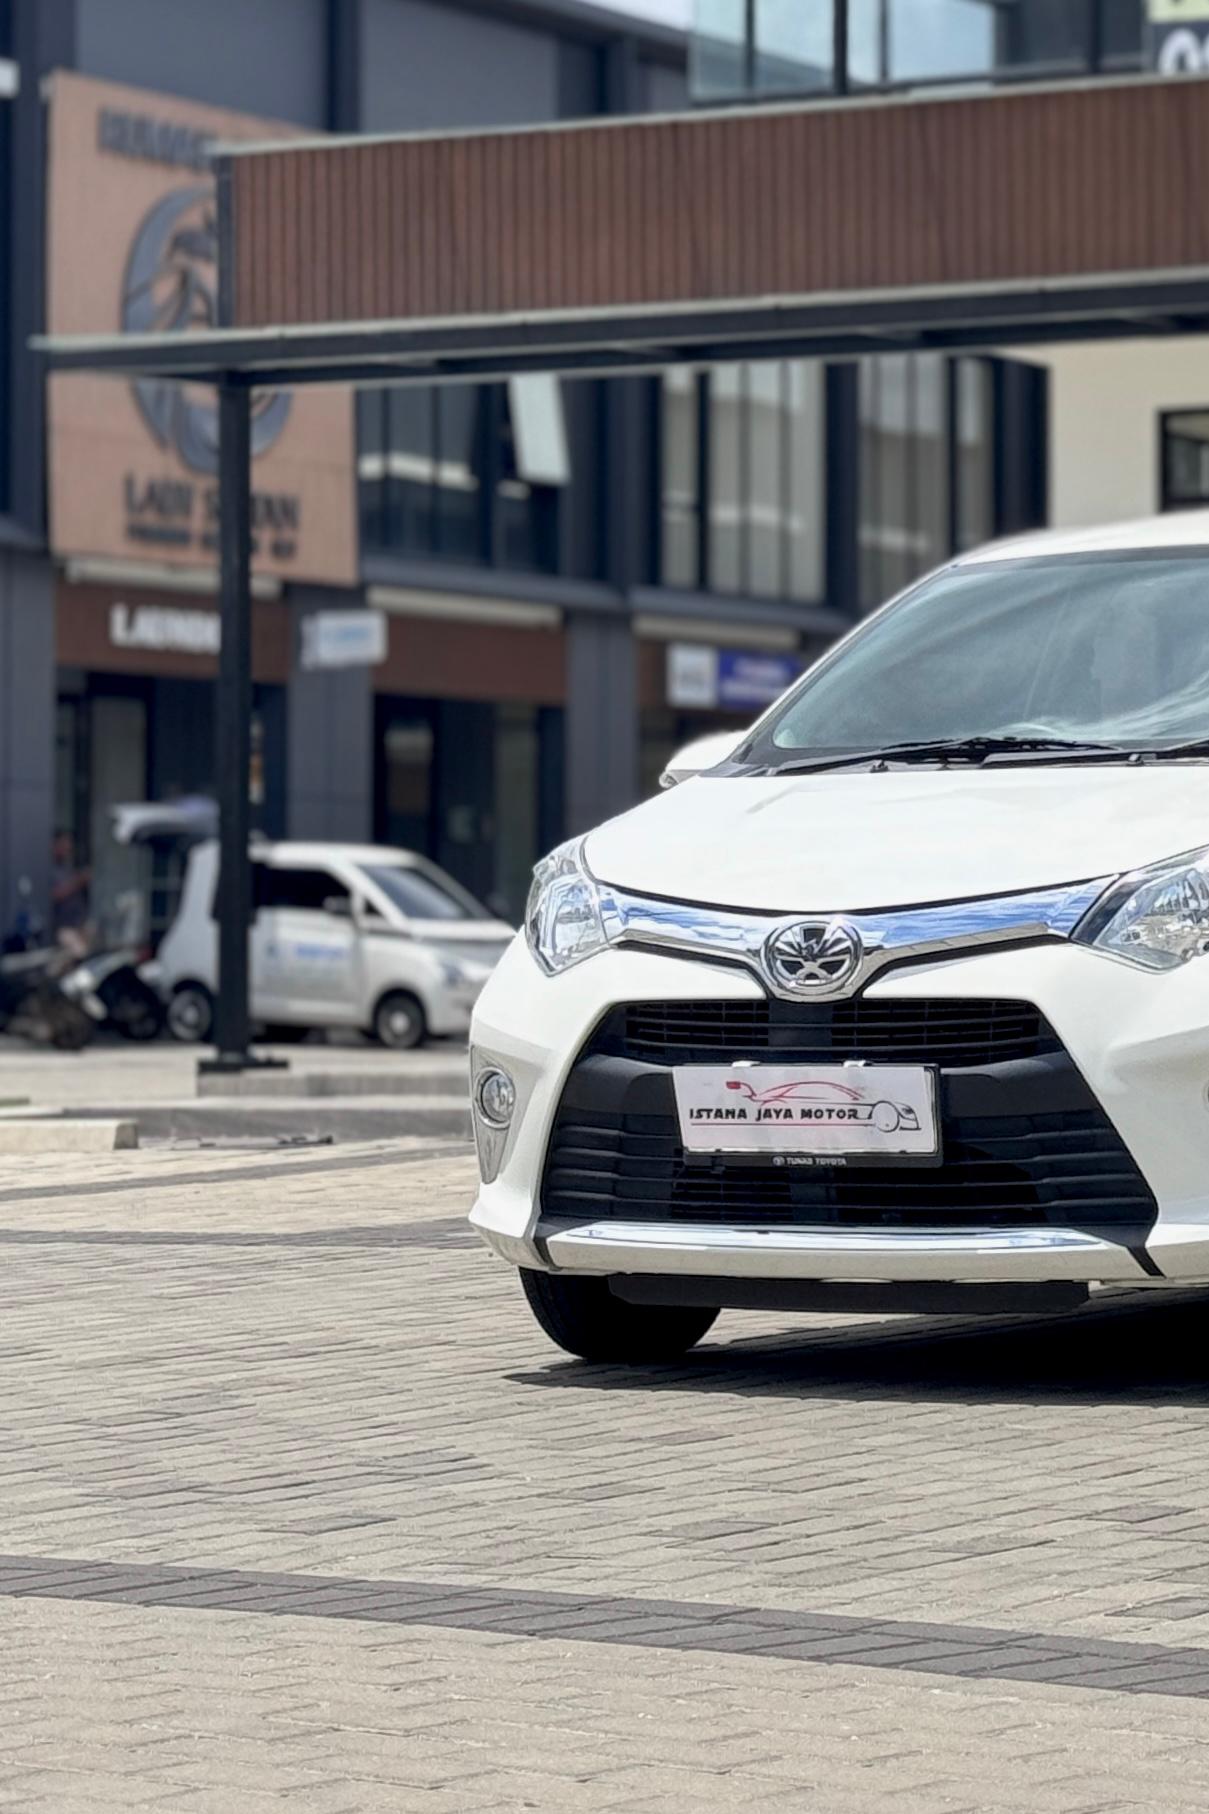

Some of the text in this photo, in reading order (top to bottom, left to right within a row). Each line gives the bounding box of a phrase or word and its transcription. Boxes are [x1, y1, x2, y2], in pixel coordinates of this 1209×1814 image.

[689, 1108, 859, 1121] ISTANA JAYA MOTOR
[815, 1157, 847, 1166] TOYOTA
